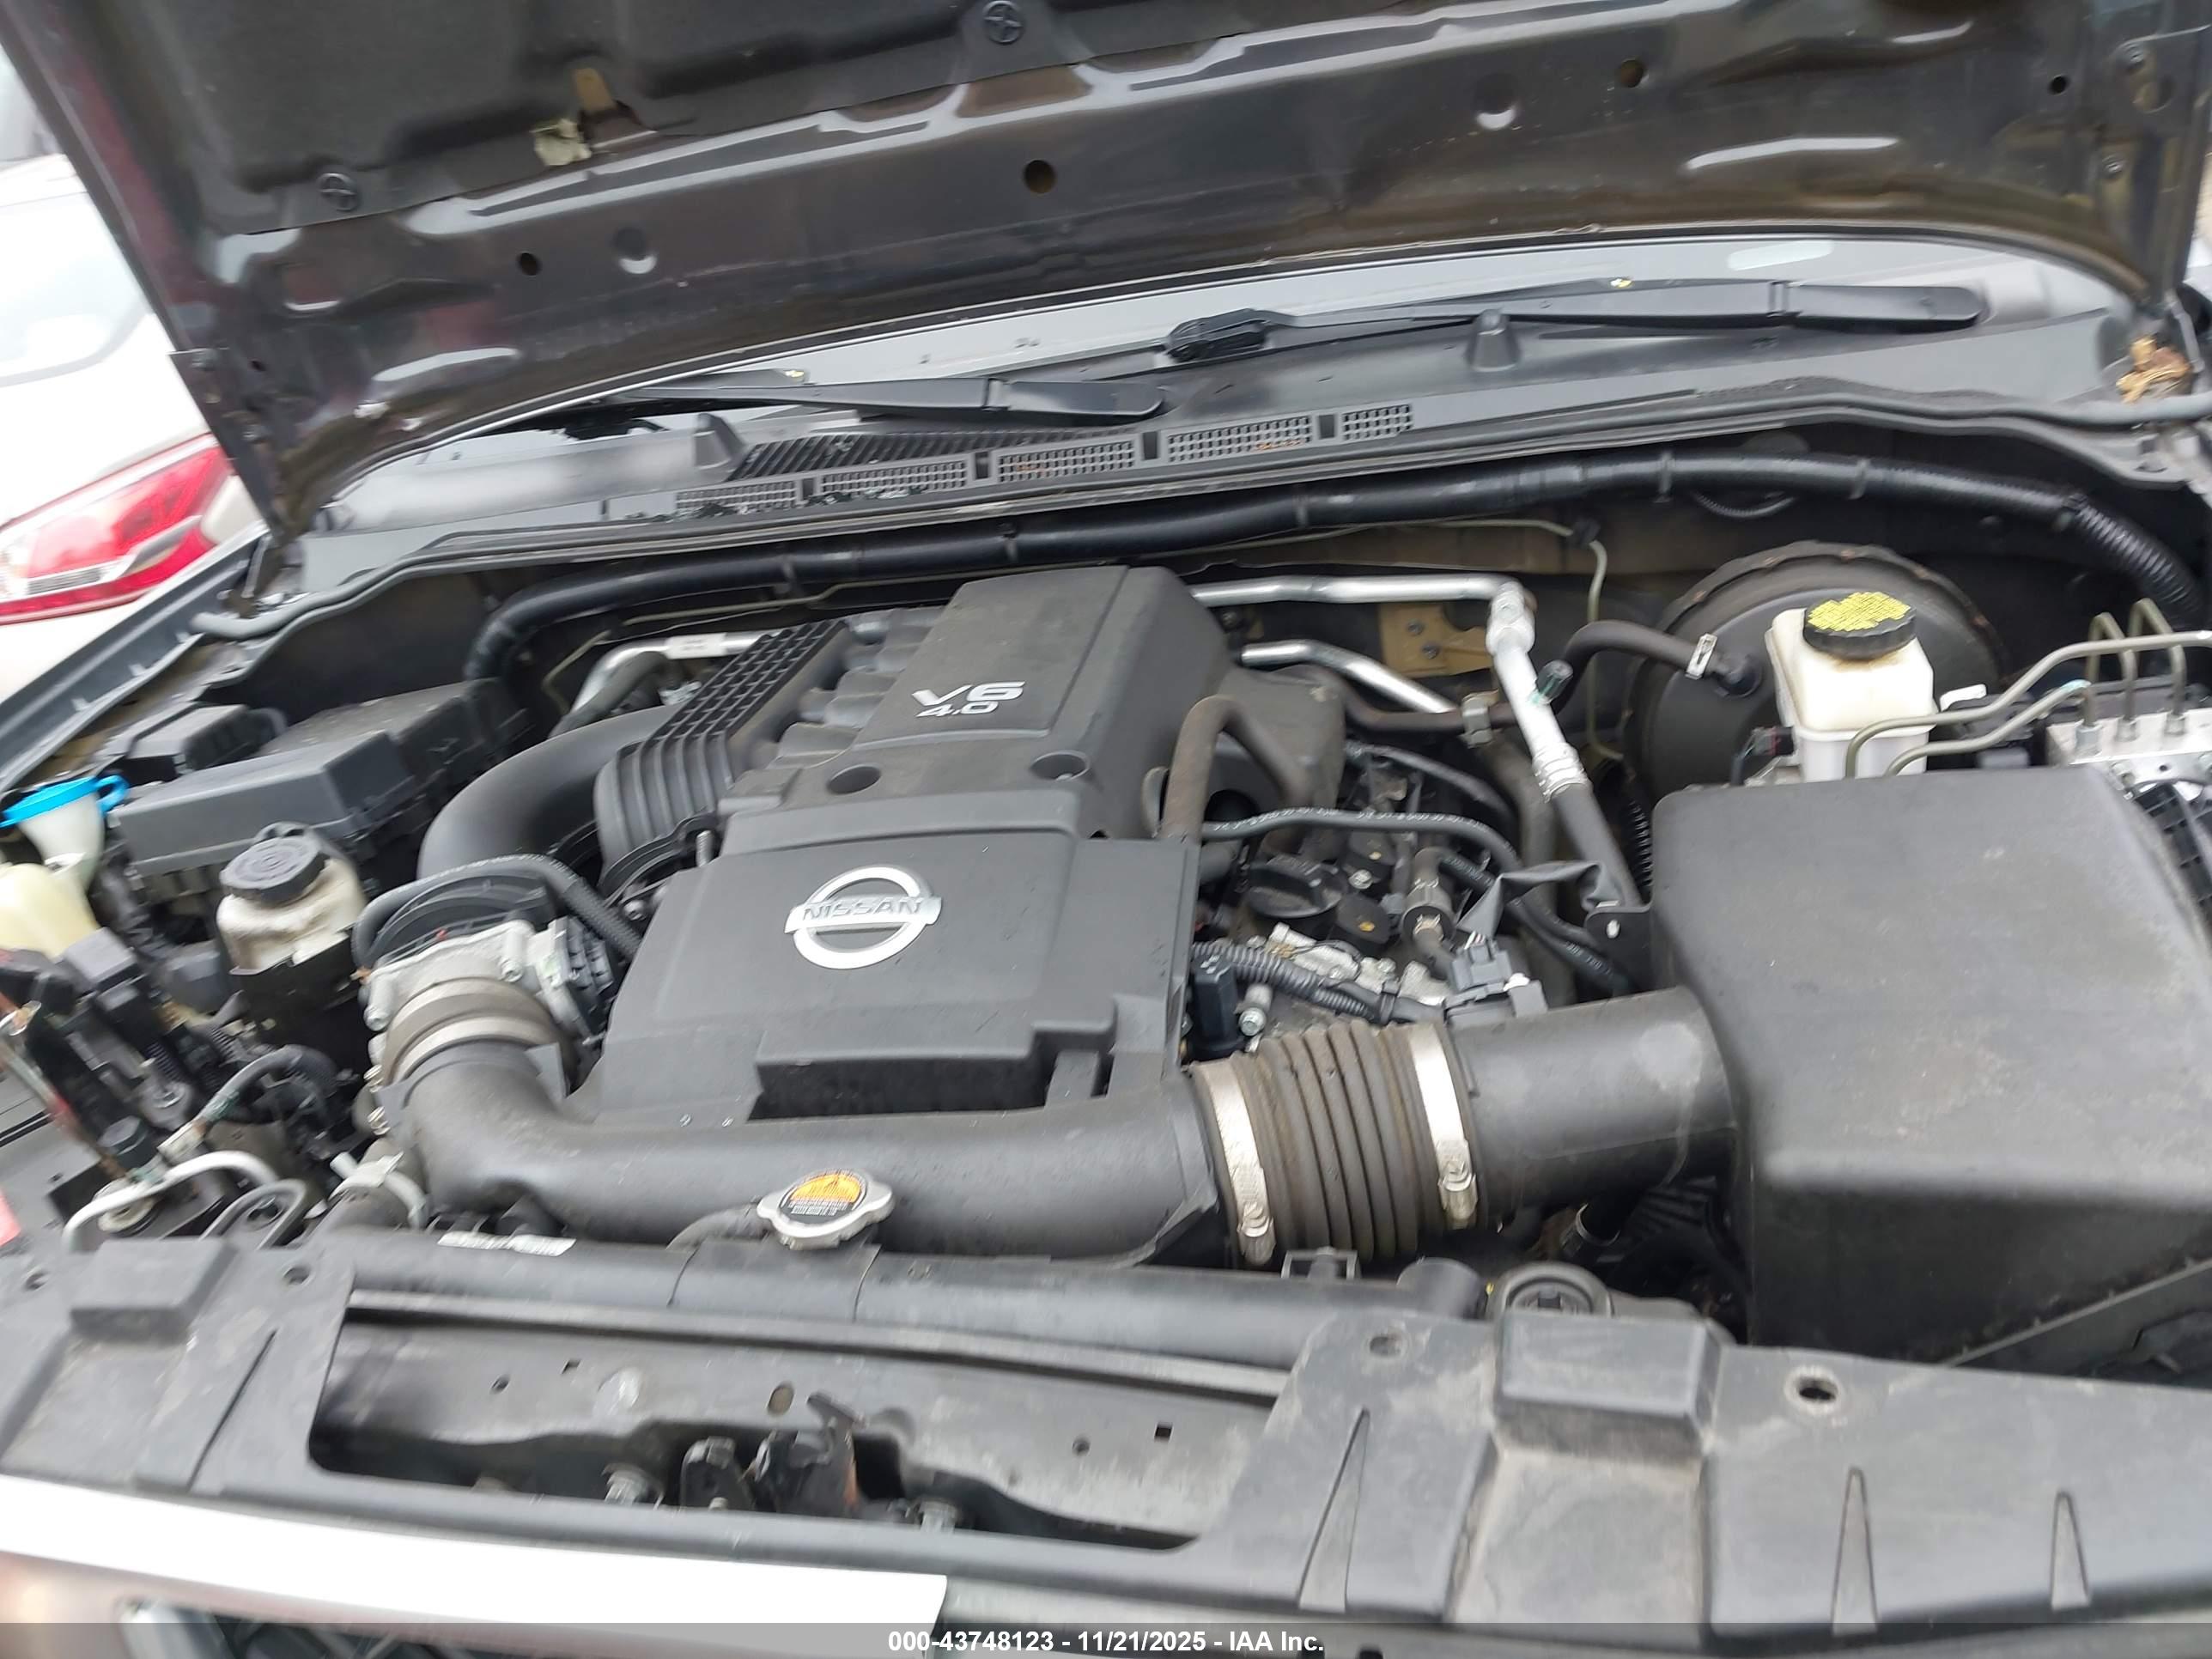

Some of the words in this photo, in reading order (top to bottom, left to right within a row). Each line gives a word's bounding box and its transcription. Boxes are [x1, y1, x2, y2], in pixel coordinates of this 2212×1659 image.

[911, 681, 1025, 706] V6
[915, 701, 999, 718] 4.0
[802, 896, 924, 921] NISSAN
